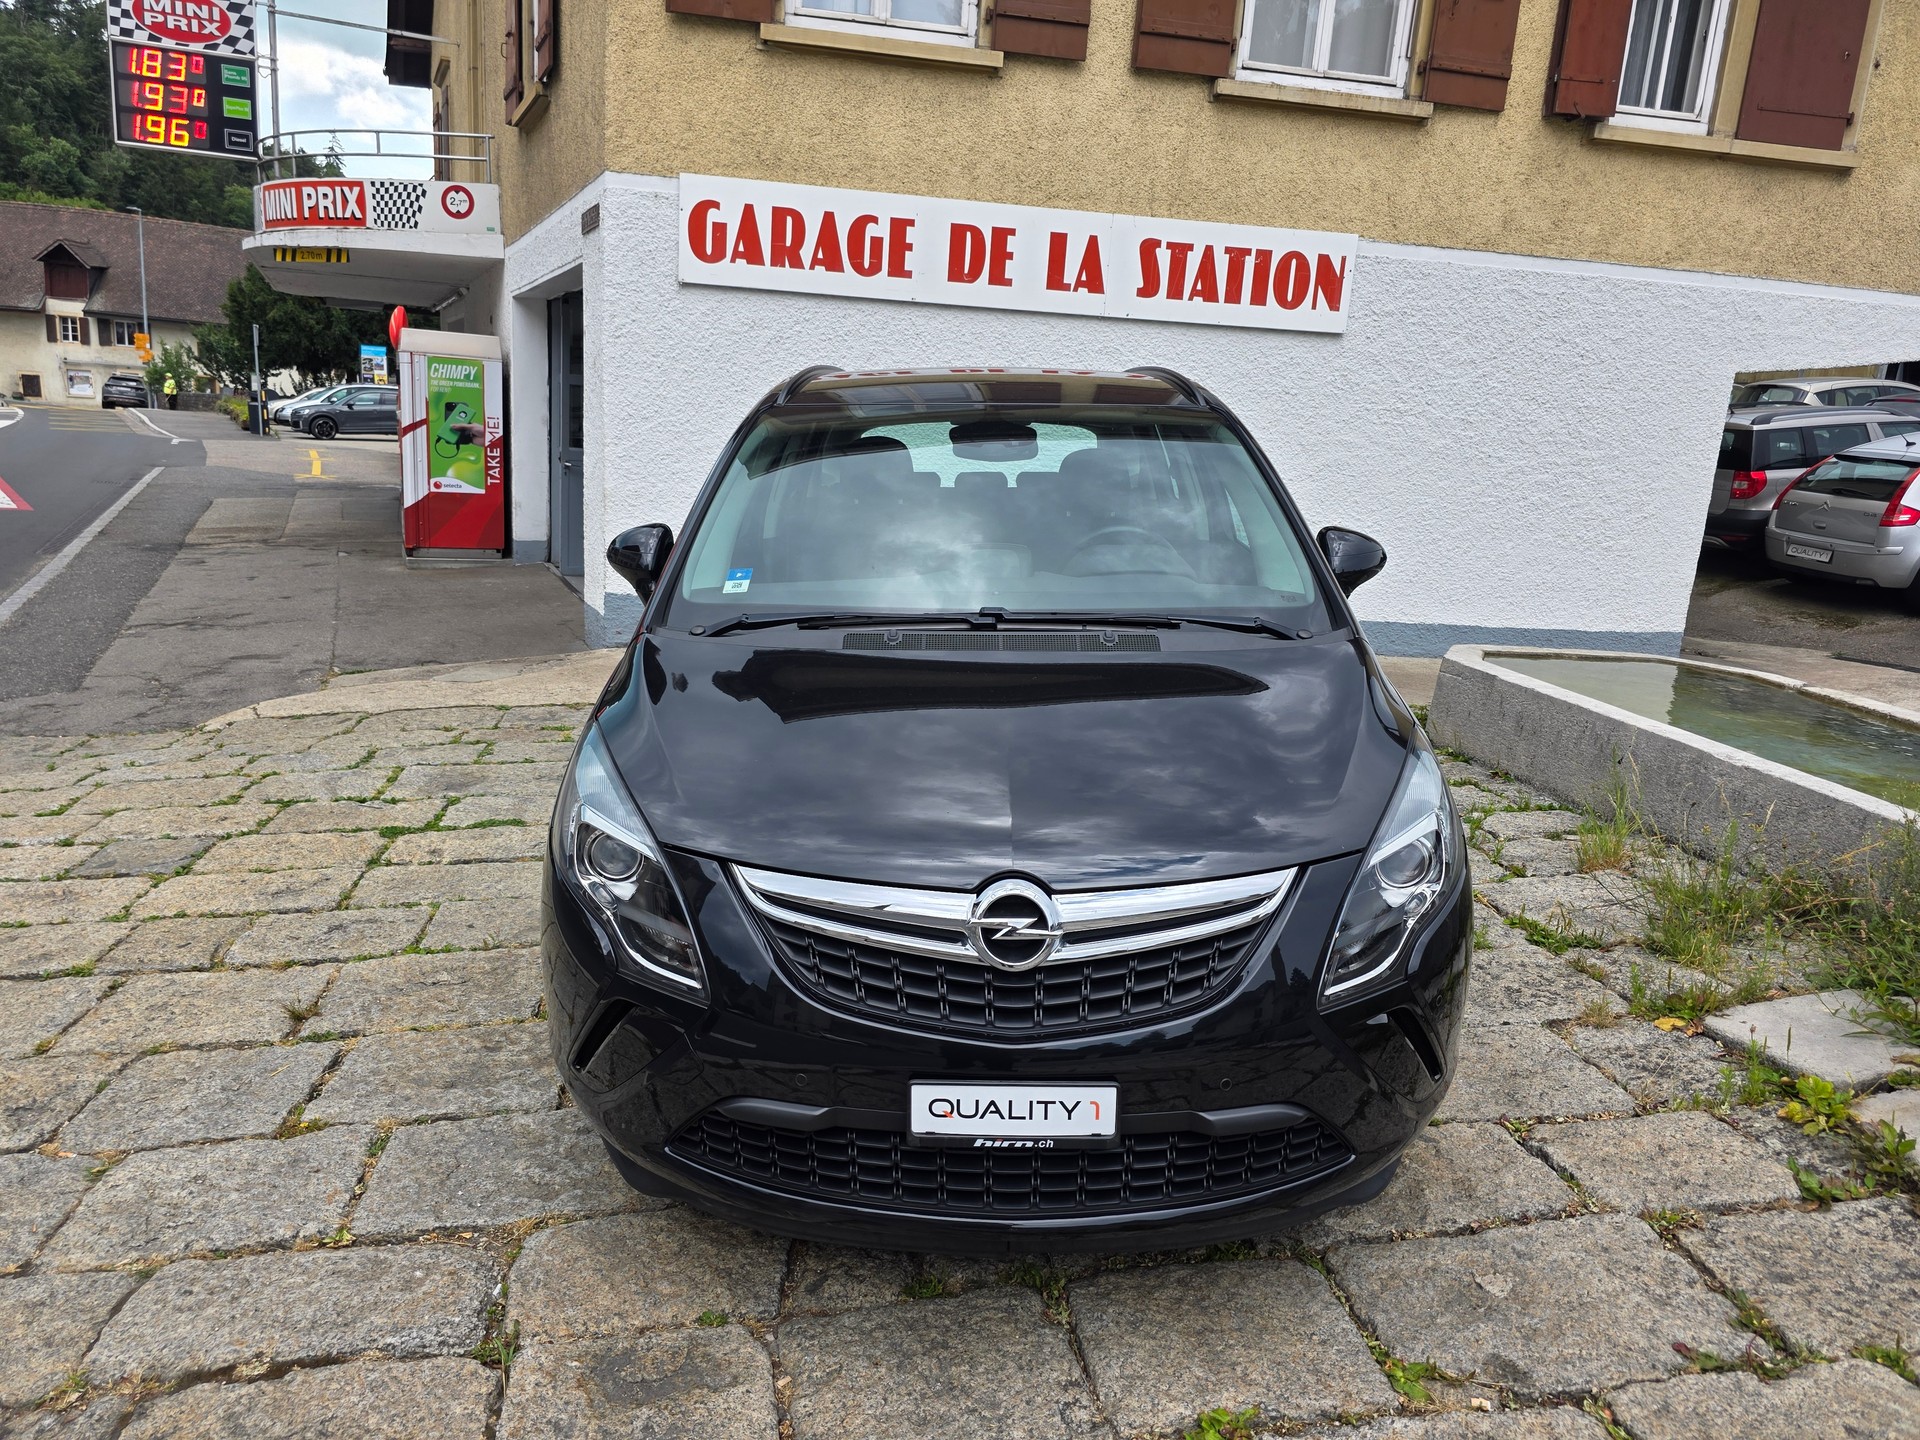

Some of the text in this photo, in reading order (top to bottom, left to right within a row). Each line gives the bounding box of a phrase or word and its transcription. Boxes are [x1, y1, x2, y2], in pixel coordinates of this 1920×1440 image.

[143, 0, 220, 21] MINI
[143, 11, 222, 36] PRIX
[264, 186, 362, 222] MINI PRIX
[687, 199, 1348, 313] GARAGE DE LA STATION
[430, 363, 478, 381] CHIMPY
[487, 447, 501, 486] TAKE
[1790, 546, 1825, 559] QUALITY
[973, 1138, 1054, 1149] hirn.ch
